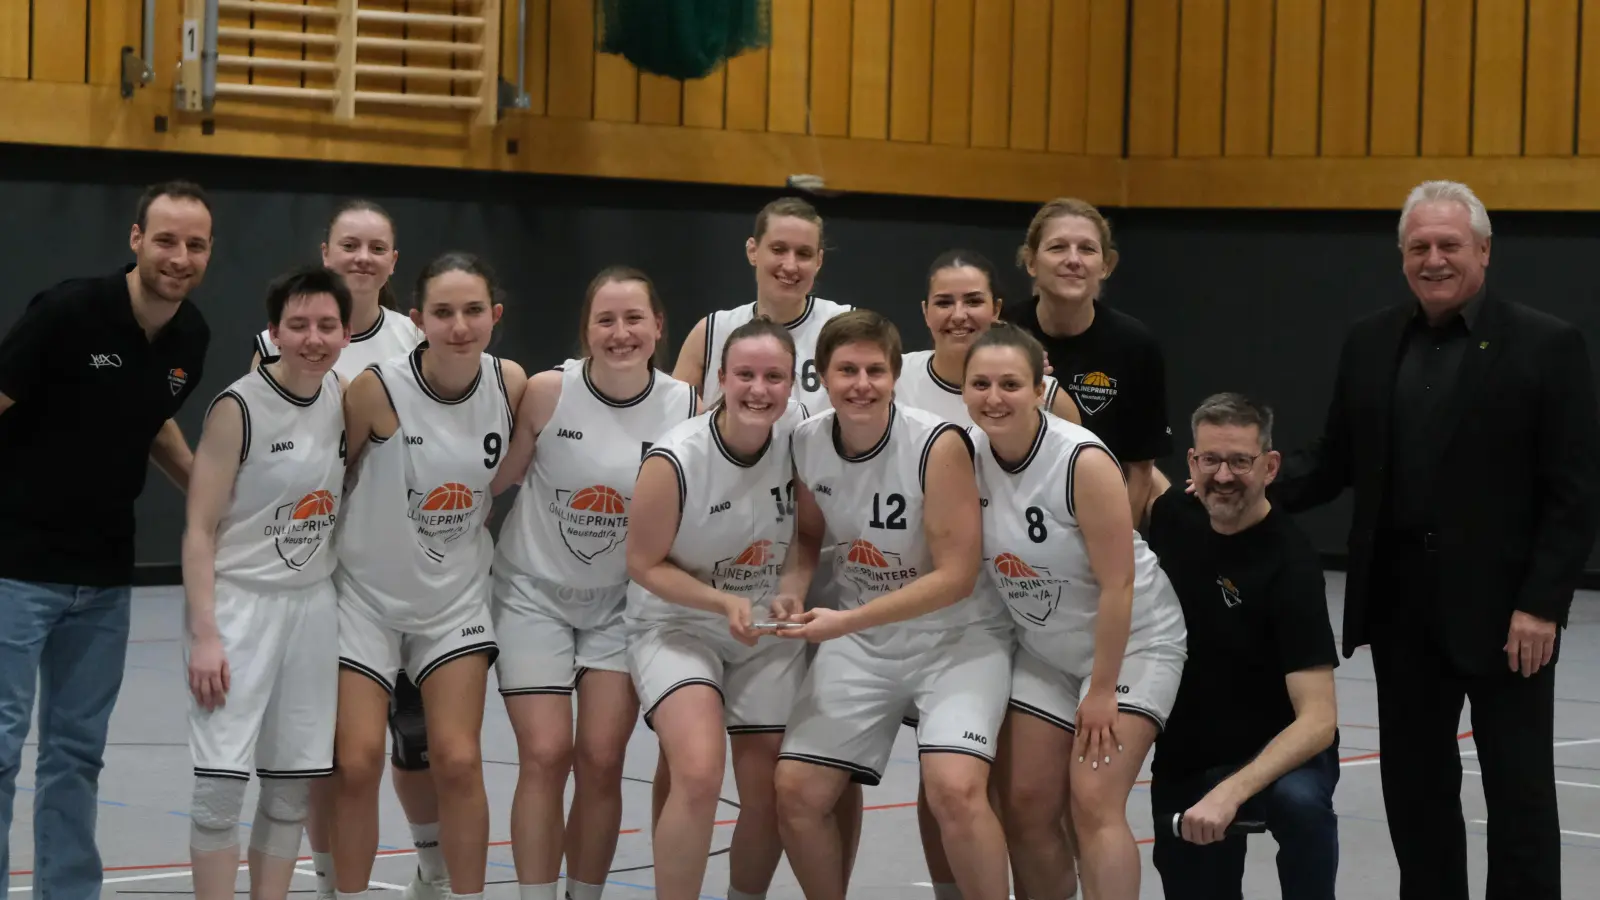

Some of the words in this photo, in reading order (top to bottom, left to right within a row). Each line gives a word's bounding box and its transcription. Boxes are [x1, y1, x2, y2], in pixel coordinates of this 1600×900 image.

[188, 28, 195, 53] 1
[802, 359, 820, 392] 6
[556, 428, 583, 440] JAKO
[271, 441, 294, 453] JAKO
[483, 432, 502, 469] 9
[549, 502, 629, 528] ONLINEPRINTE
[709, 501, 731, 515] JAKO
[869, 492, 907, 530] 12
[1025, 505, 1048, 544] 8
[461, 625, 485, 637] JAKO
[962, 731, 987, 745] JAKO
